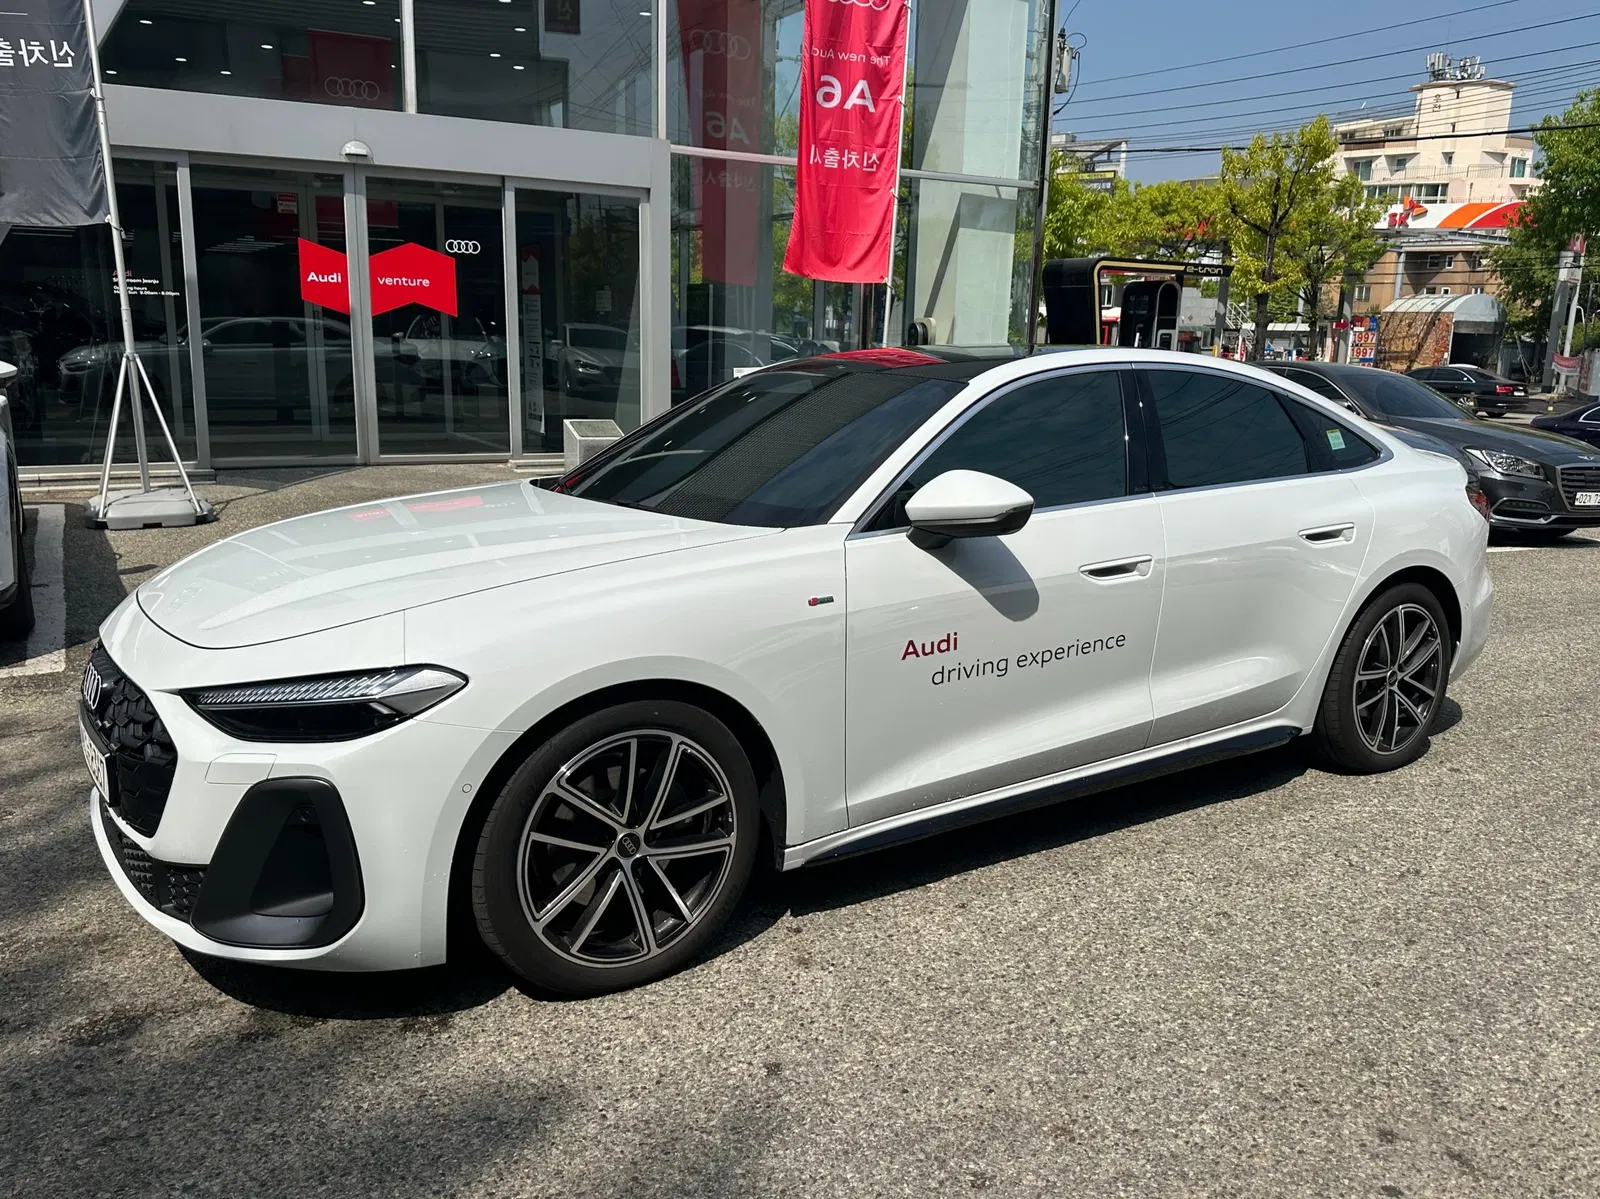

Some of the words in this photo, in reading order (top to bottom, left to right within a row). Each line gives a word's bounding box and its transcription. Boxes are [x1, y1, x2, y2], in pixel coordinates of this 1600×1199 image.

[1388, 212, 1410, 227] SK
[1186, 265, 1224, 275] e-tron
[307, 271, 342, 283] Audi
[377, 276, 430, 287] venture
[1352, 332, 1376, 343] 1997
[1351, 347, 1374, 358] 1997
[901, 632, 959, 661] Audi
[931, 657, 1009, 686] driving
[1016, 634, 1126, 668] experience
